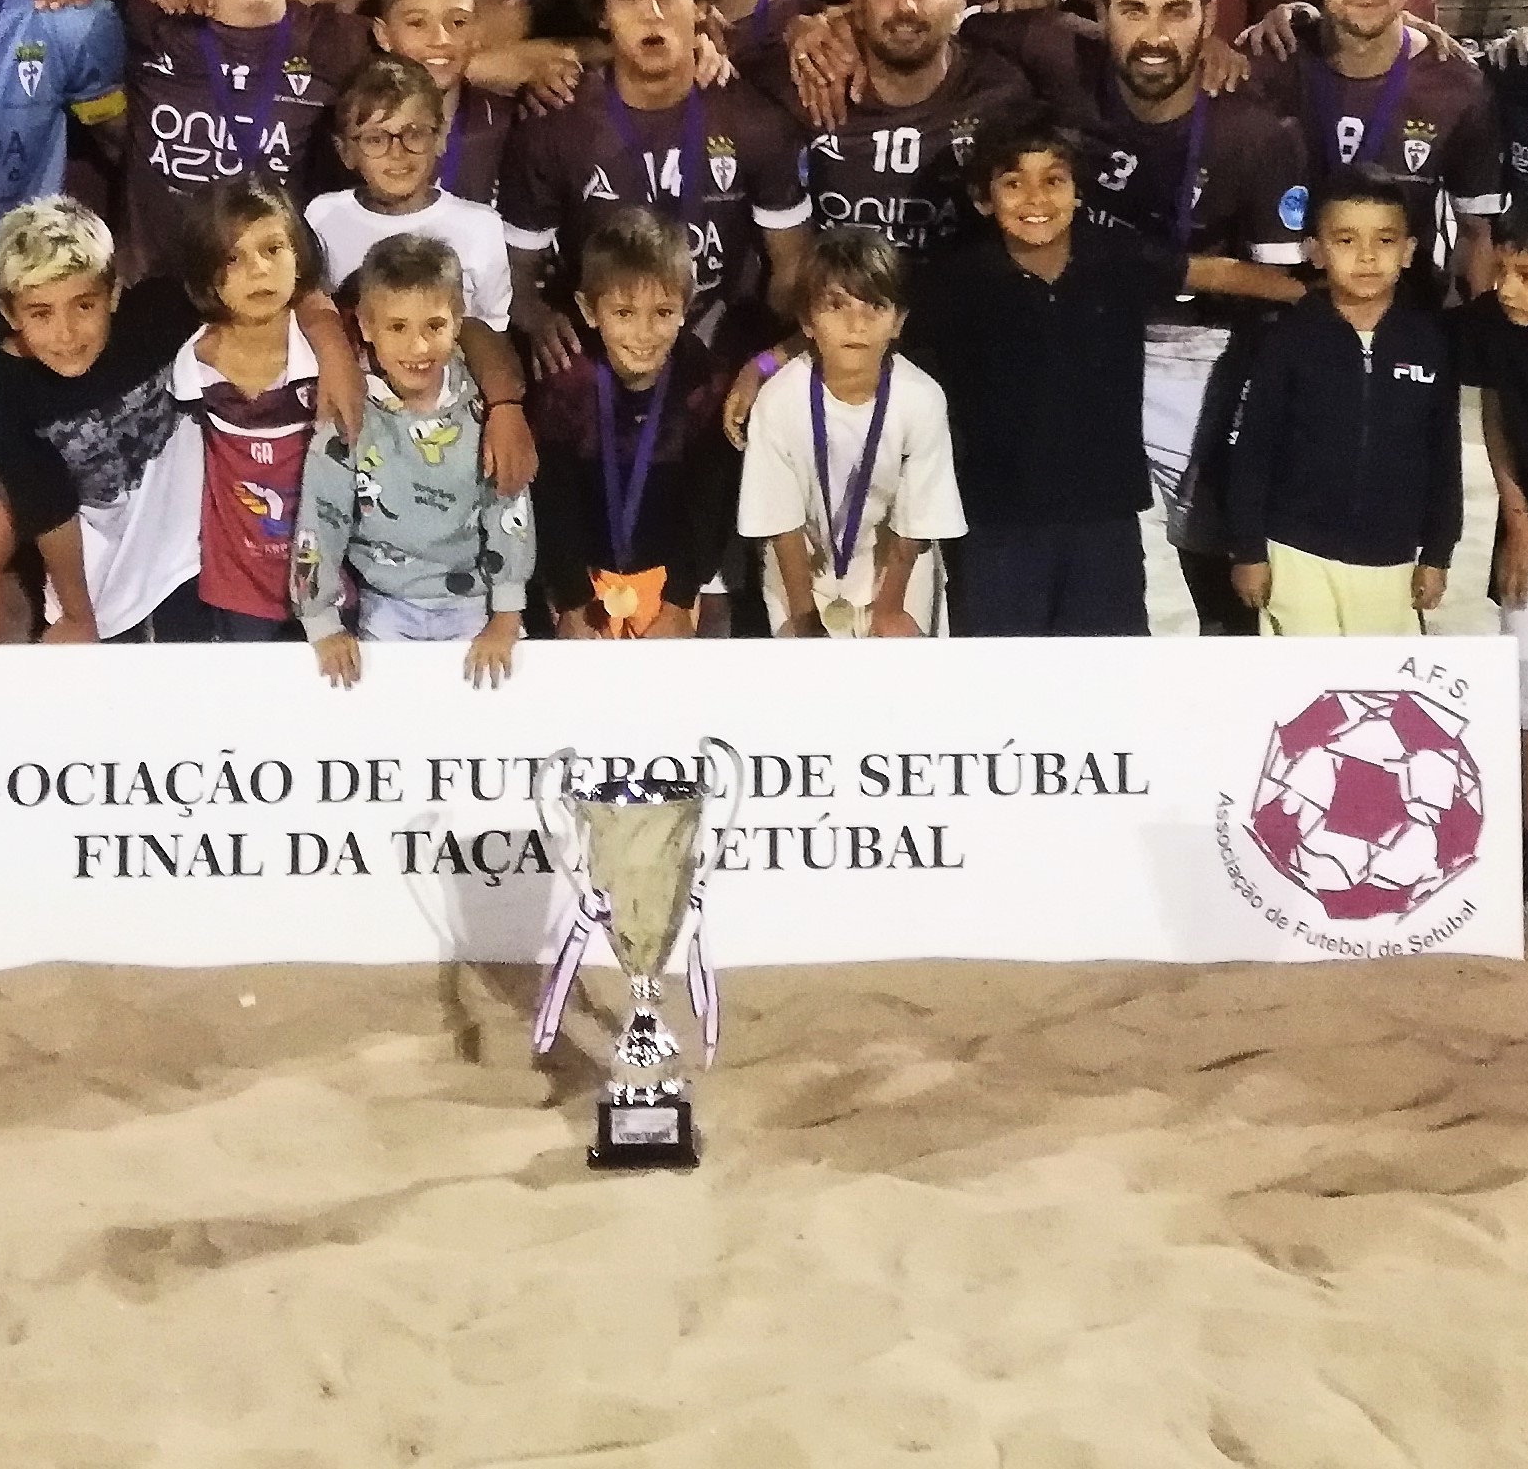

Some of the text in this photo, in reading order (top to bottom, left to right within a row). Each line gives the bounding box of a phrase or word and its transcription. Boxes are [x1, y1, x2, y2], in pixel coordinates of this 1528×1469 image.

[872, 126, 922, 174] 10
[1337, 116, 1365, 164] 8
[642, 147, 684, 204] 14
[1097, 150, 1139, 192] 3
[819, 191, 957, 225] ONDA
[316, 757, 404, 805] DE
[747, 754, 836, 799] DE
[858, 738, 1151, 798] SETÚBAL
[73, 811, 967, 888] FINAL DA TAÇA ETÚBAL
[1264, 906, 1290, 931] de
[1292, 919, 1372, 959] Futebol
[1377, 939, 1404, 958] de
